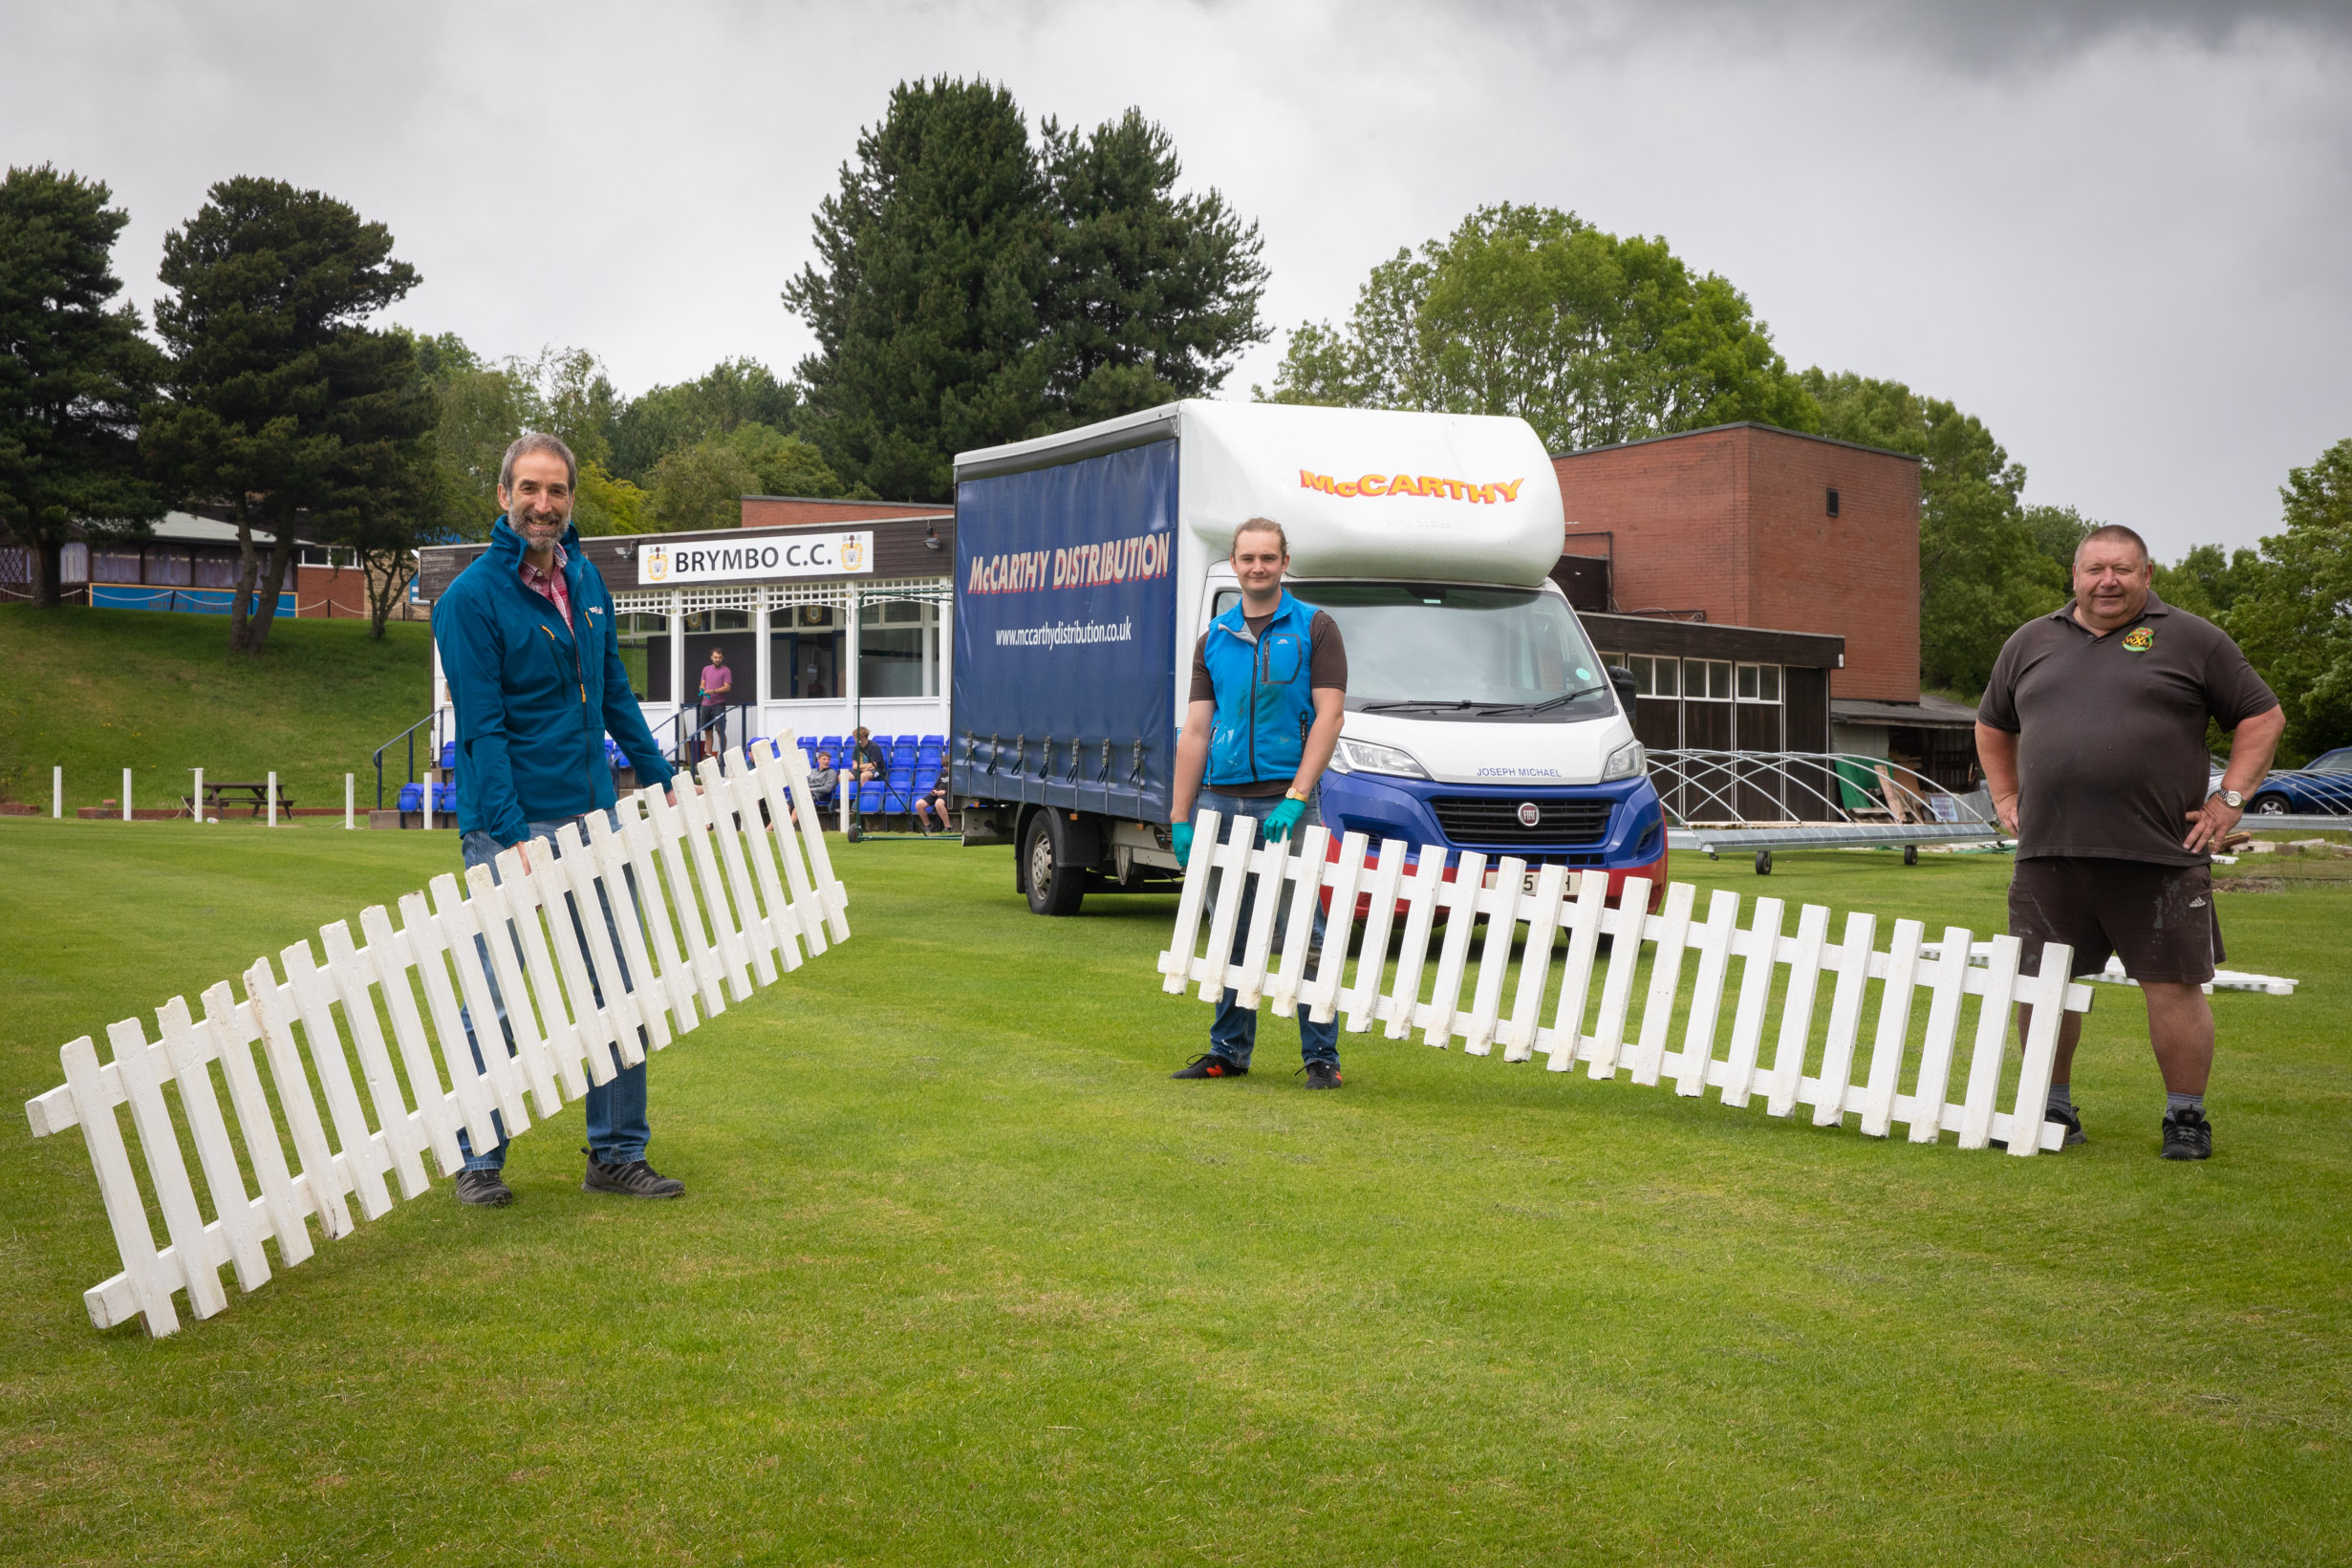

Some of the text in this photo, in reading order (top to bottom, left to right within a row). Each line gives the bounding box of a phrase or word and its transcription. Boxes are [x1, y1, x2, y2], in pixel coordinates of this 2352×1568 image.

[1300, 469, 1524, 505] McCARTHY
[676, 544, 832, 573] BRYMBO C.C.
[967, 532, 1171, 594] McCARTHY DISTRIBUTION
[996, 615, 1132, 651] www.mccarthydistribution.co.uk
[1477, 768, 1562, 778] JOSEPH MICHAEL
[1522, 809, 1536, 821] FIAT
